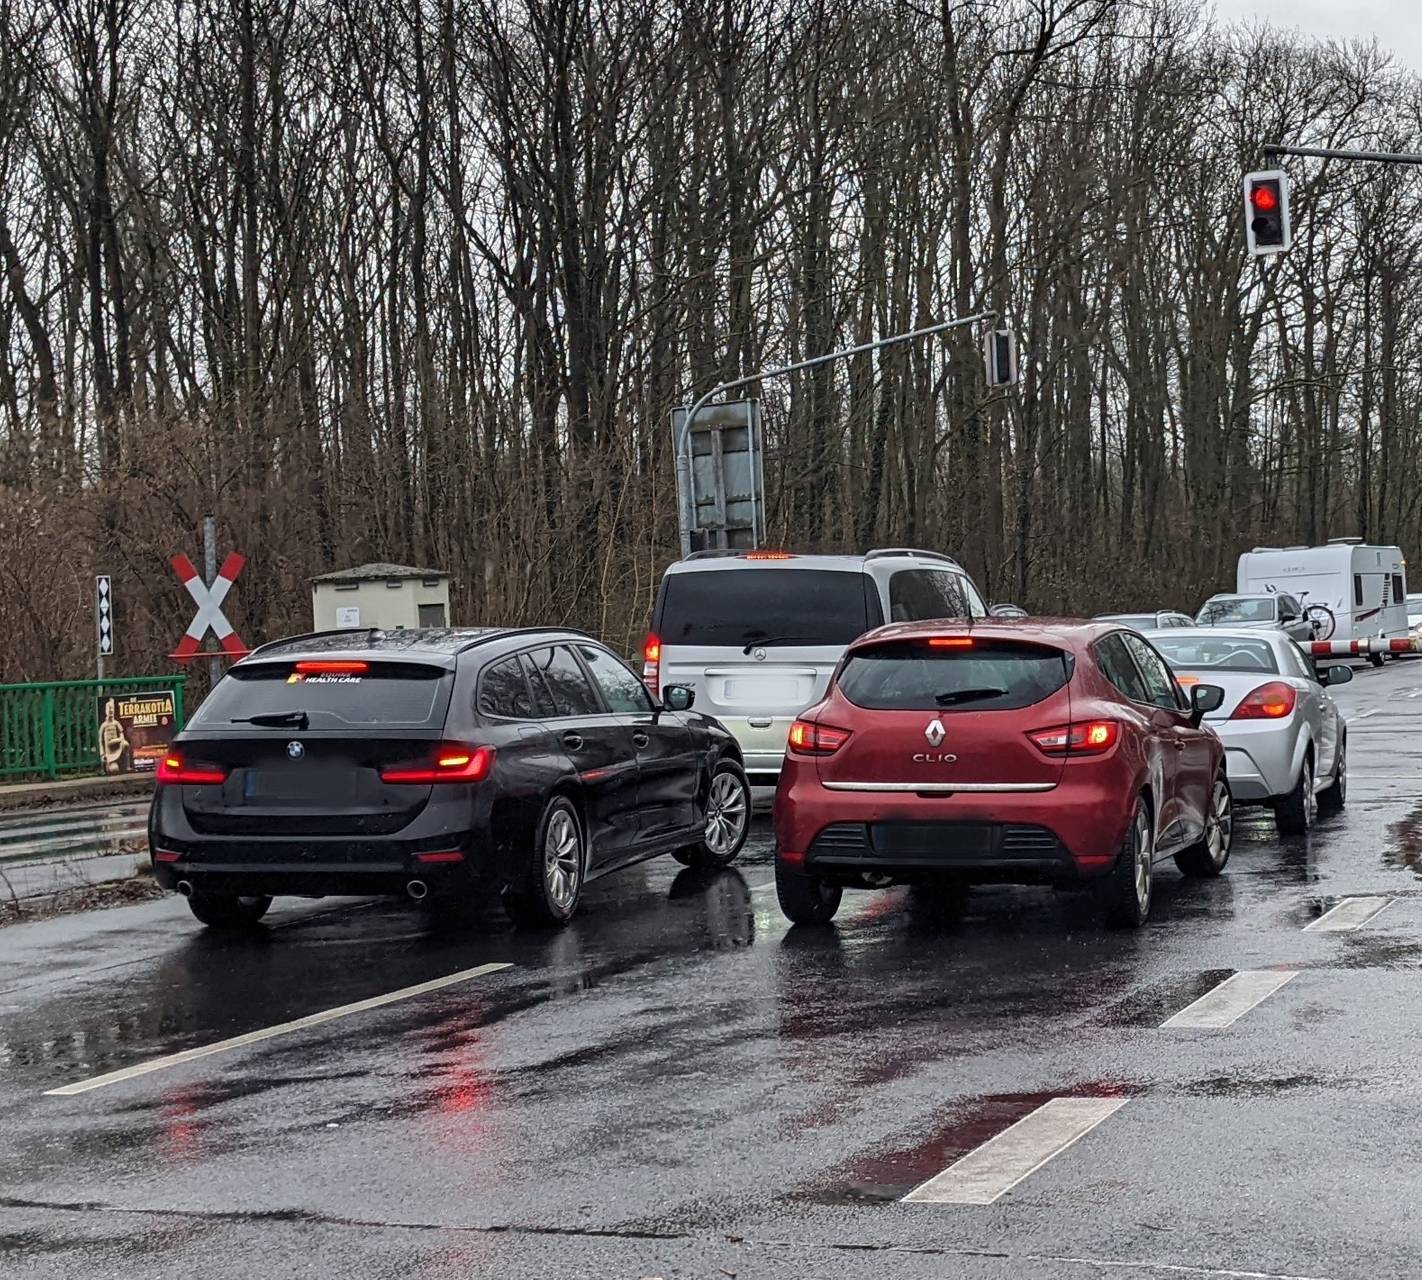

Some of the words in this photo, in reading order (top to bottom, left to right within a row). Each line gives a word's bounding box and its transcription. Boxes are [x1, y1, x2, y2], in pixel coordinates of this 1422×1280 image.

[118, 698, 173, 716] TERRAKOTTA
[133, 714, 158, 725] ARMEE
[912, 753, 957, 763] CLIO
